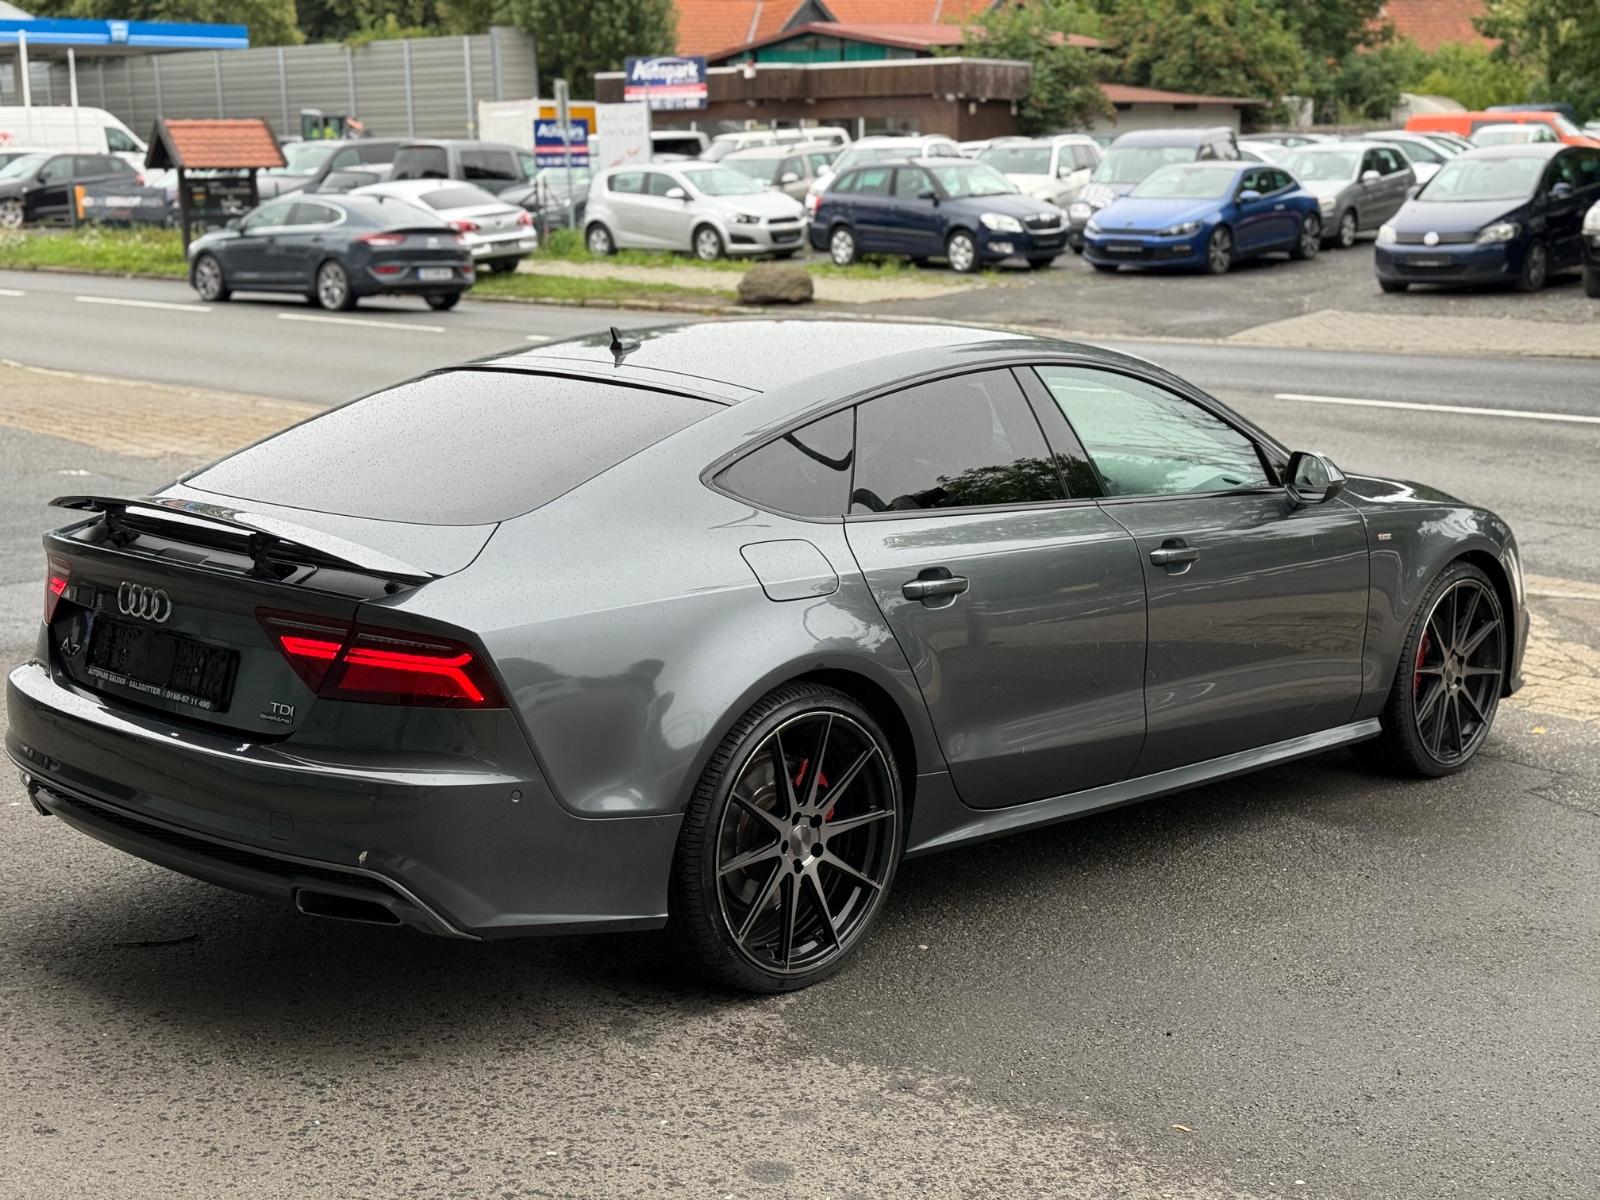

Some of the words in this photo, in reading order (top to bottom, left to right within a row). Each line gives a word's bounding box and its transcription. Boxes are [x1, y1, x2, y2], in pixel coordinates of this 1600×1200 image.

[631, 59, 699, 85] Autopark
[60, 636, 81, 656] A7
[128, 680, 161, 695] SALZGITTER
[270, 701, 295, 717] TDI
[259, 713, 290, 724] quattro
